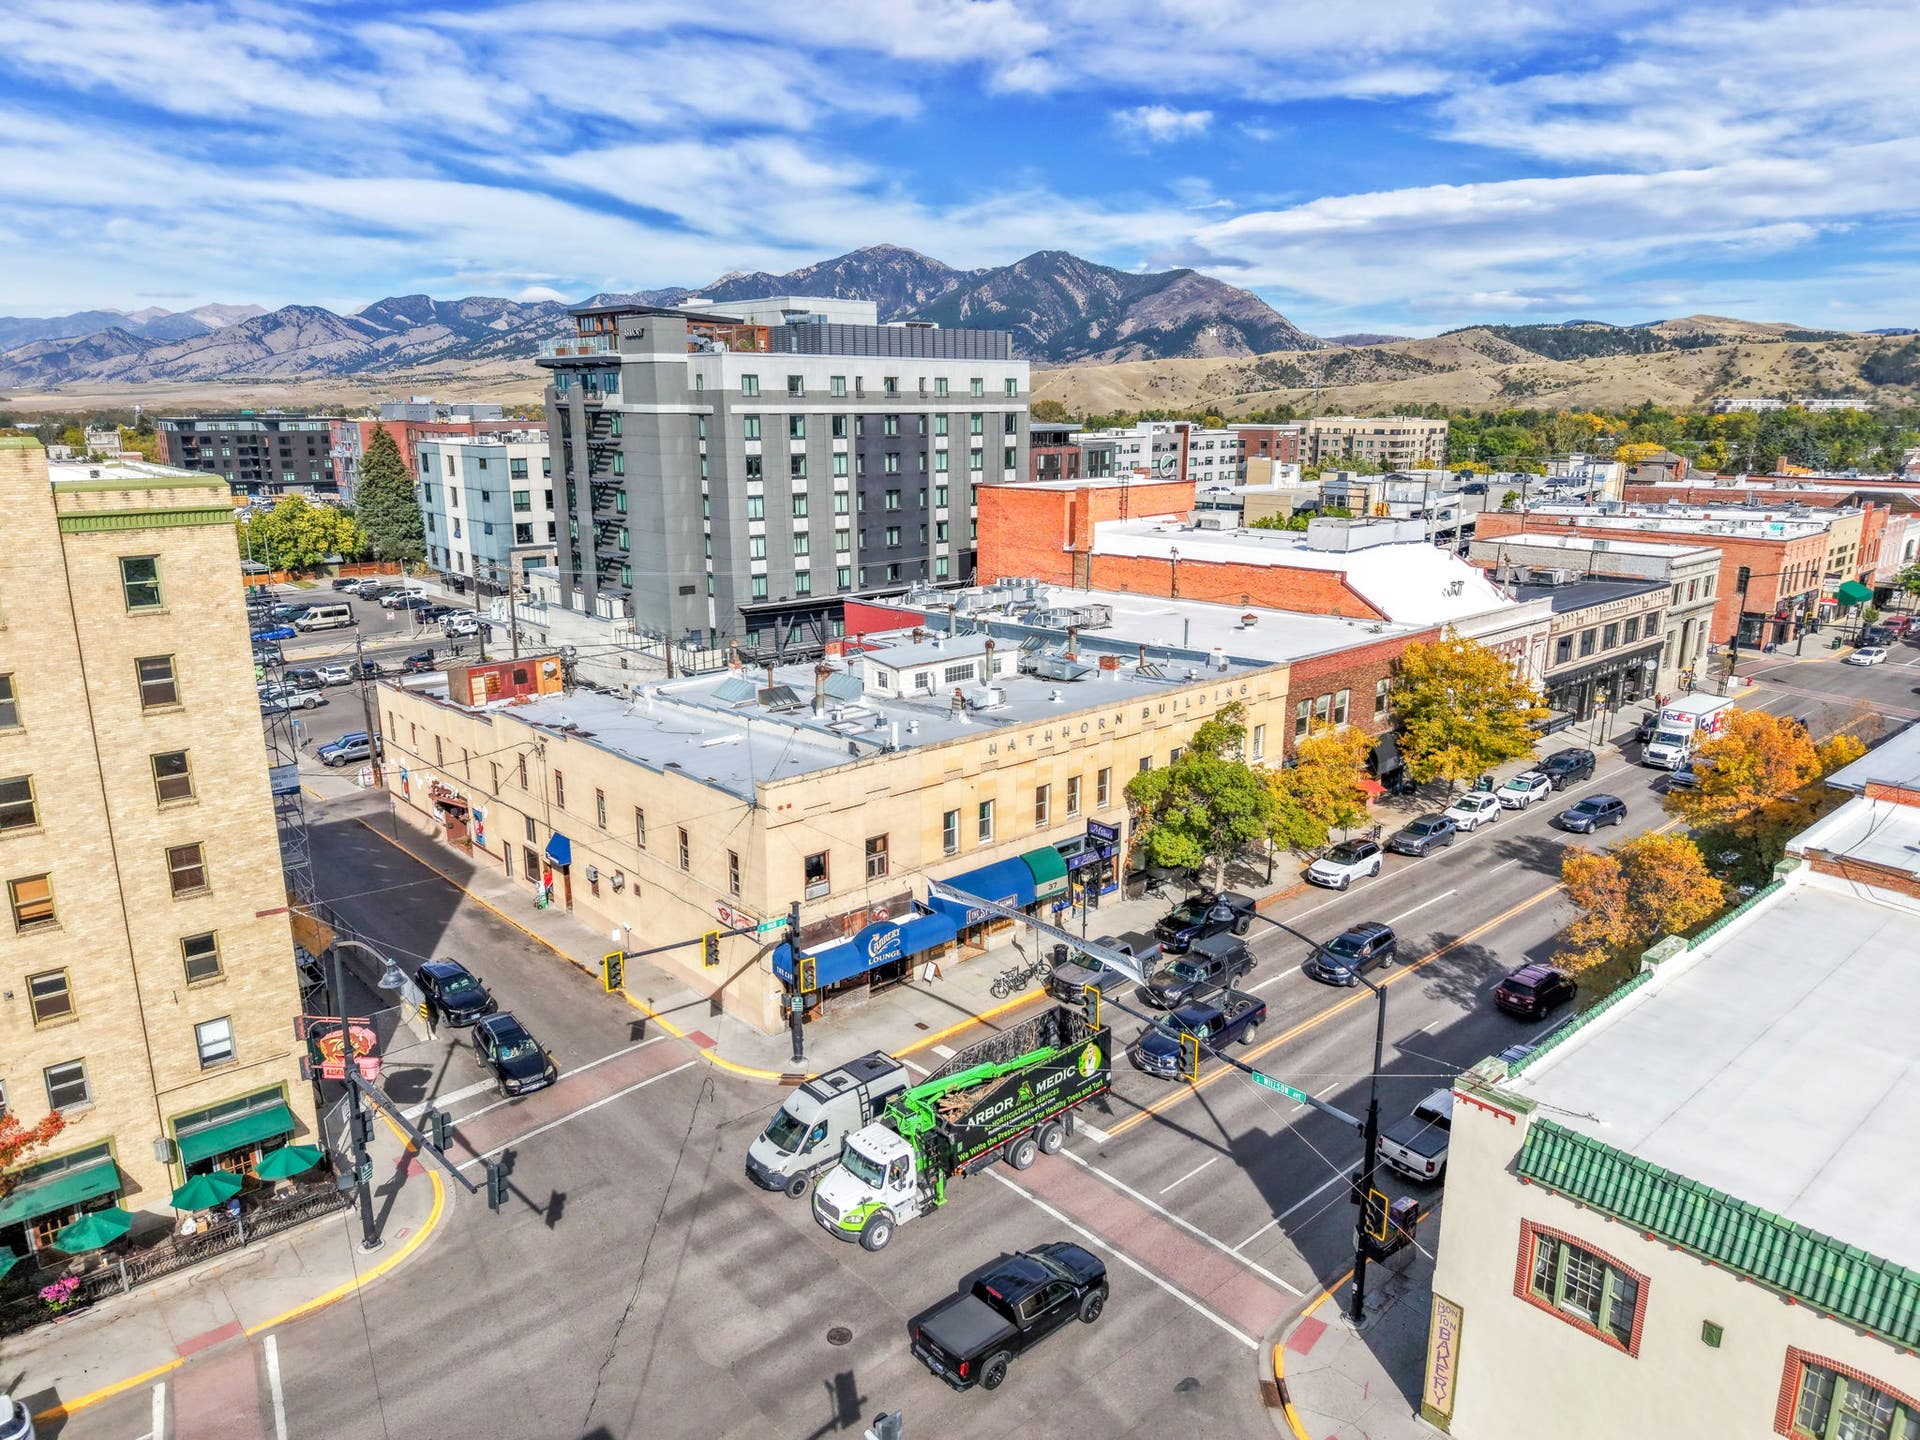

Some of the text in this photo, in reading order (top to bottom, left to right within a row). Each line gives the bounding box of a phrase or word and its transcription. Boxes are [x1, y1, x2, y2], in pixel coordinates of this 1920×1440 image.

[989, 684, 1247, 755] HATHHORN BUILDING
[1662, 711, 1692, 723] FedEx
[1048, 882, 1058, 891] 37
[868, 949, 902, 966] LOUNGE
[1263, 1077, 1289, 1095] WILLSON
[965, 1097, 1014, 1132] ARBOR
[1036, 1065, 1076, 1095] MEDIC
[1036, 1087, 1060, 1104] SERVICES
[958, 1078, 1104, 1162] We Write the Prescriptions For Healthy Trees and Turf
[1438, 1302, 1458, 1318] BON
[1439, 1314, 1457, 1331] TON
[1433, 1327, 1451, 1405] BAKERY
